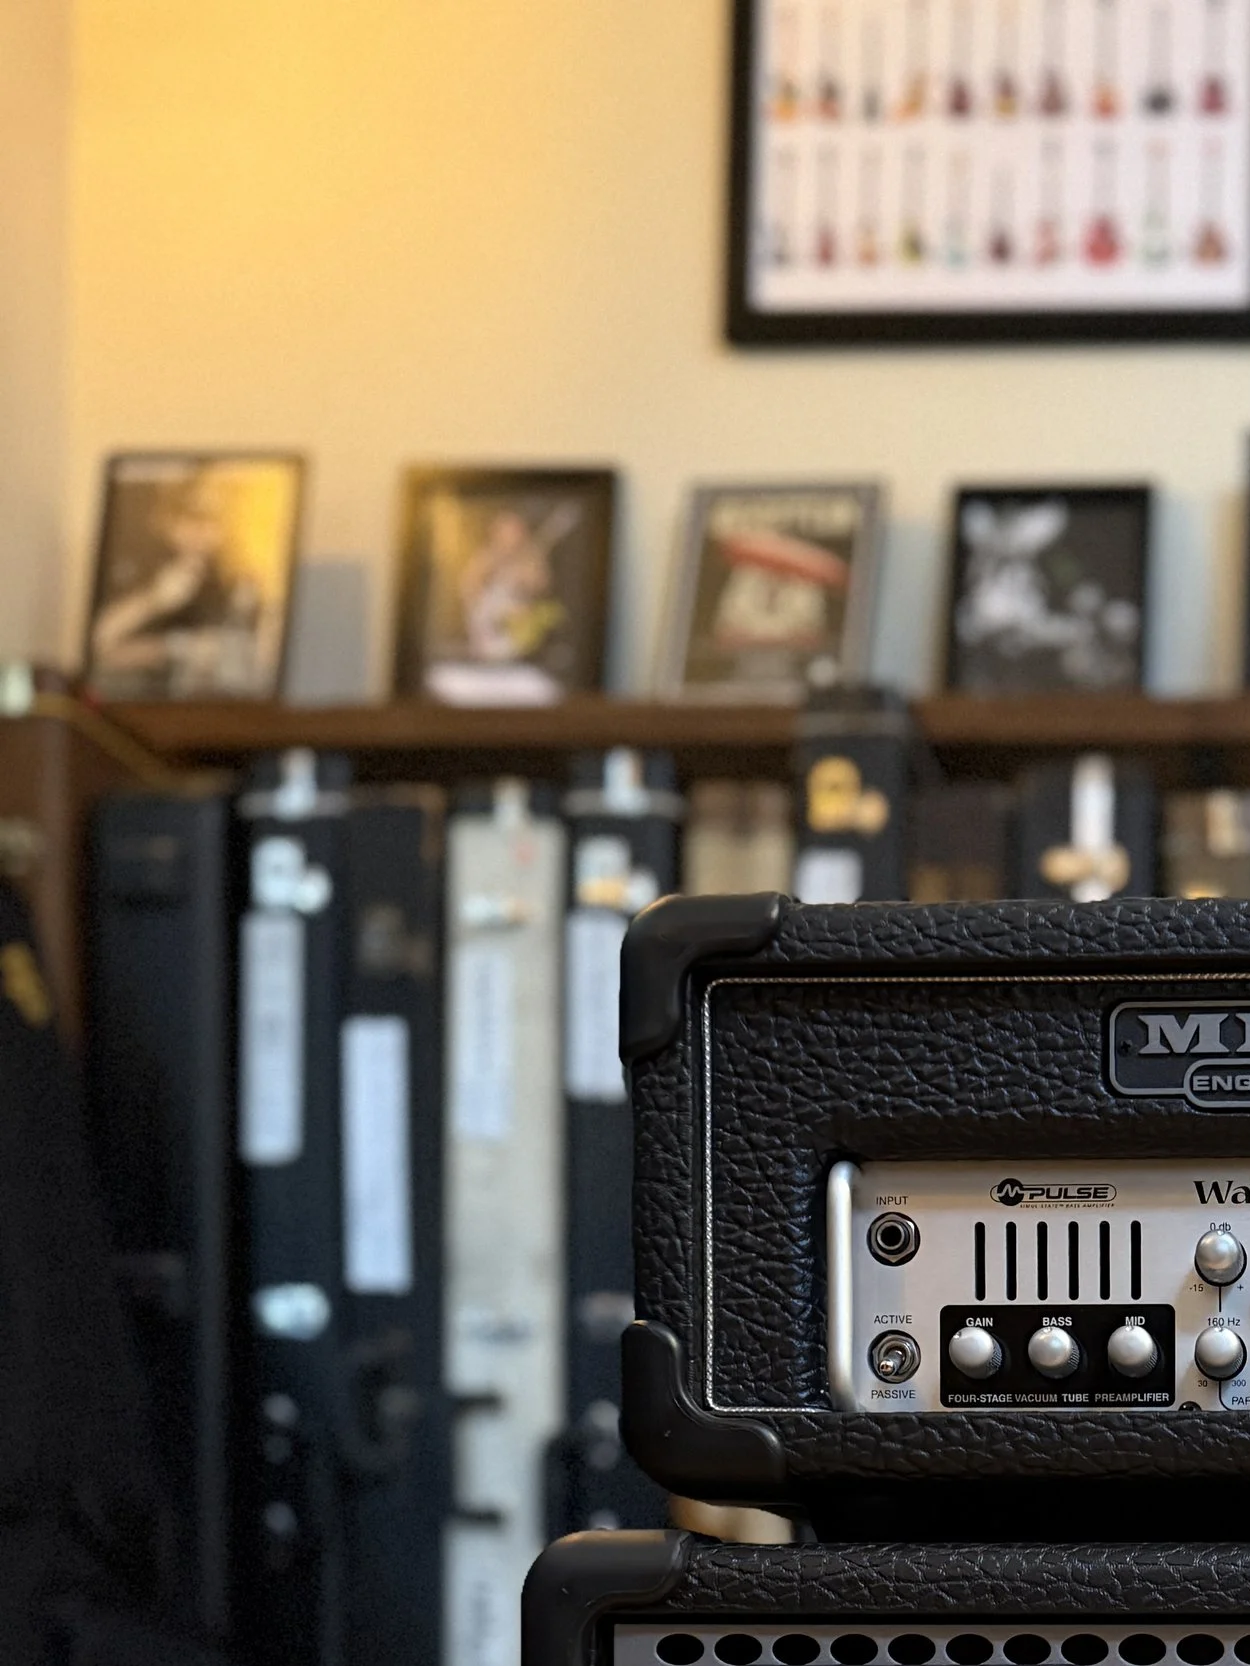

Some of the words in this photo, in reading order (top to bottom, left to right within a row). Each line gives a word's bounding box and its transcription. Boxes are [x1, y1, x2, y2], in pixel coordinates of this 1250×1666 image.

[875, 1196, 909, 1206] INPUT
[873, 1315, 913, 1325] ACTIVE
[966, 1317, 994, 1327] GAIN
[1042, 1316, 1073, 1327] BASS
[1124, 1316, 1146, 1326] MID
[1207, 1317, 1225, 1327] 160
[1227, 1317, 1241, 1327] Hz
[1231, 1379, 1247, 1388] 300
[870, 1389, 917, 1400] PASSIVE
[1014, 1393, 1058, 1403] VACUUM
[1061, 1393, 1090, 1402] TUBE
[1094, 1392, 1170, 1402] PREAMPLIFIER
